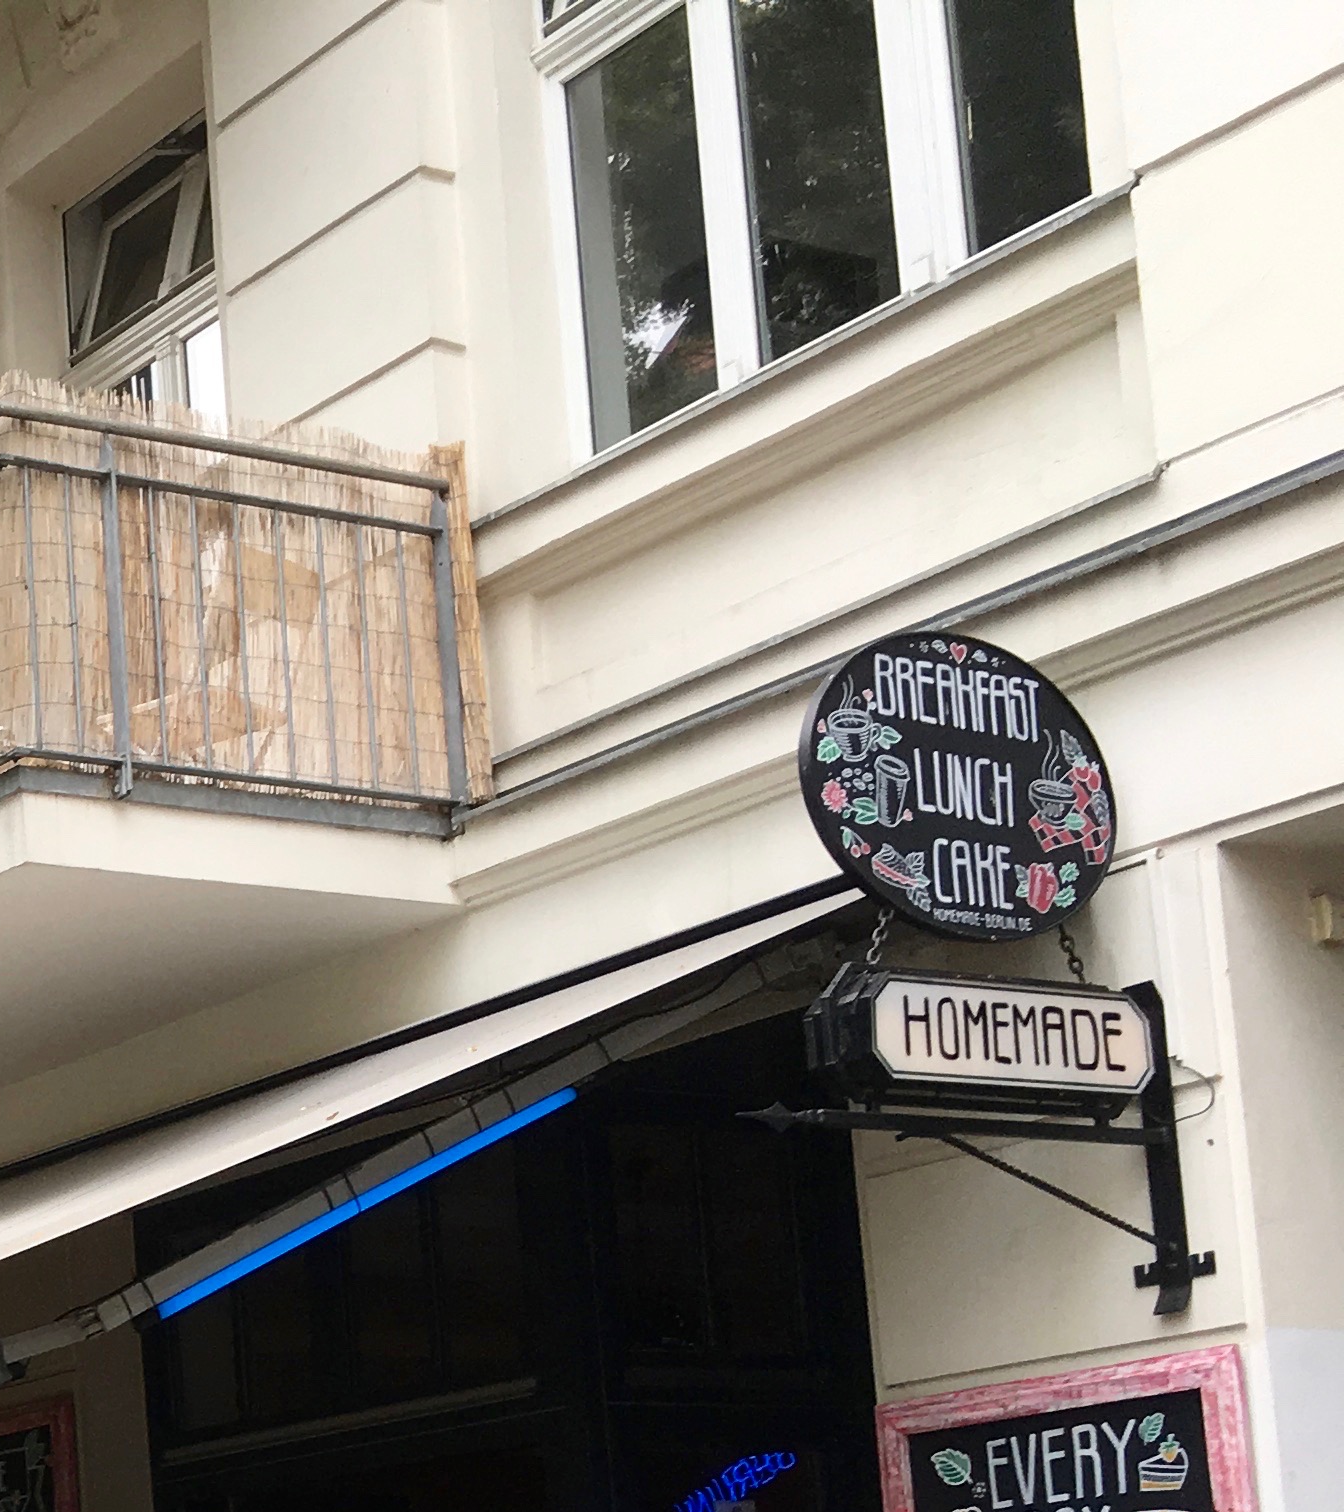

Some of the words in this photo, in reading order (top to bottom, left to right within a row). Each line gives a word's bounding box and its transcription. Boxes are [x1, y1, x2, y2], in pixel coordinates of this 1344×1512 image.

[874, 653, 1040, 743] BREAKFAST
[913, 748, 1015, 828] LUNCH
[933, 838, 1015, 910] CAKE
[903, 994, 1127, 1072] HOMEMADE
[985, 1418, 1136, 1510] EVERY
